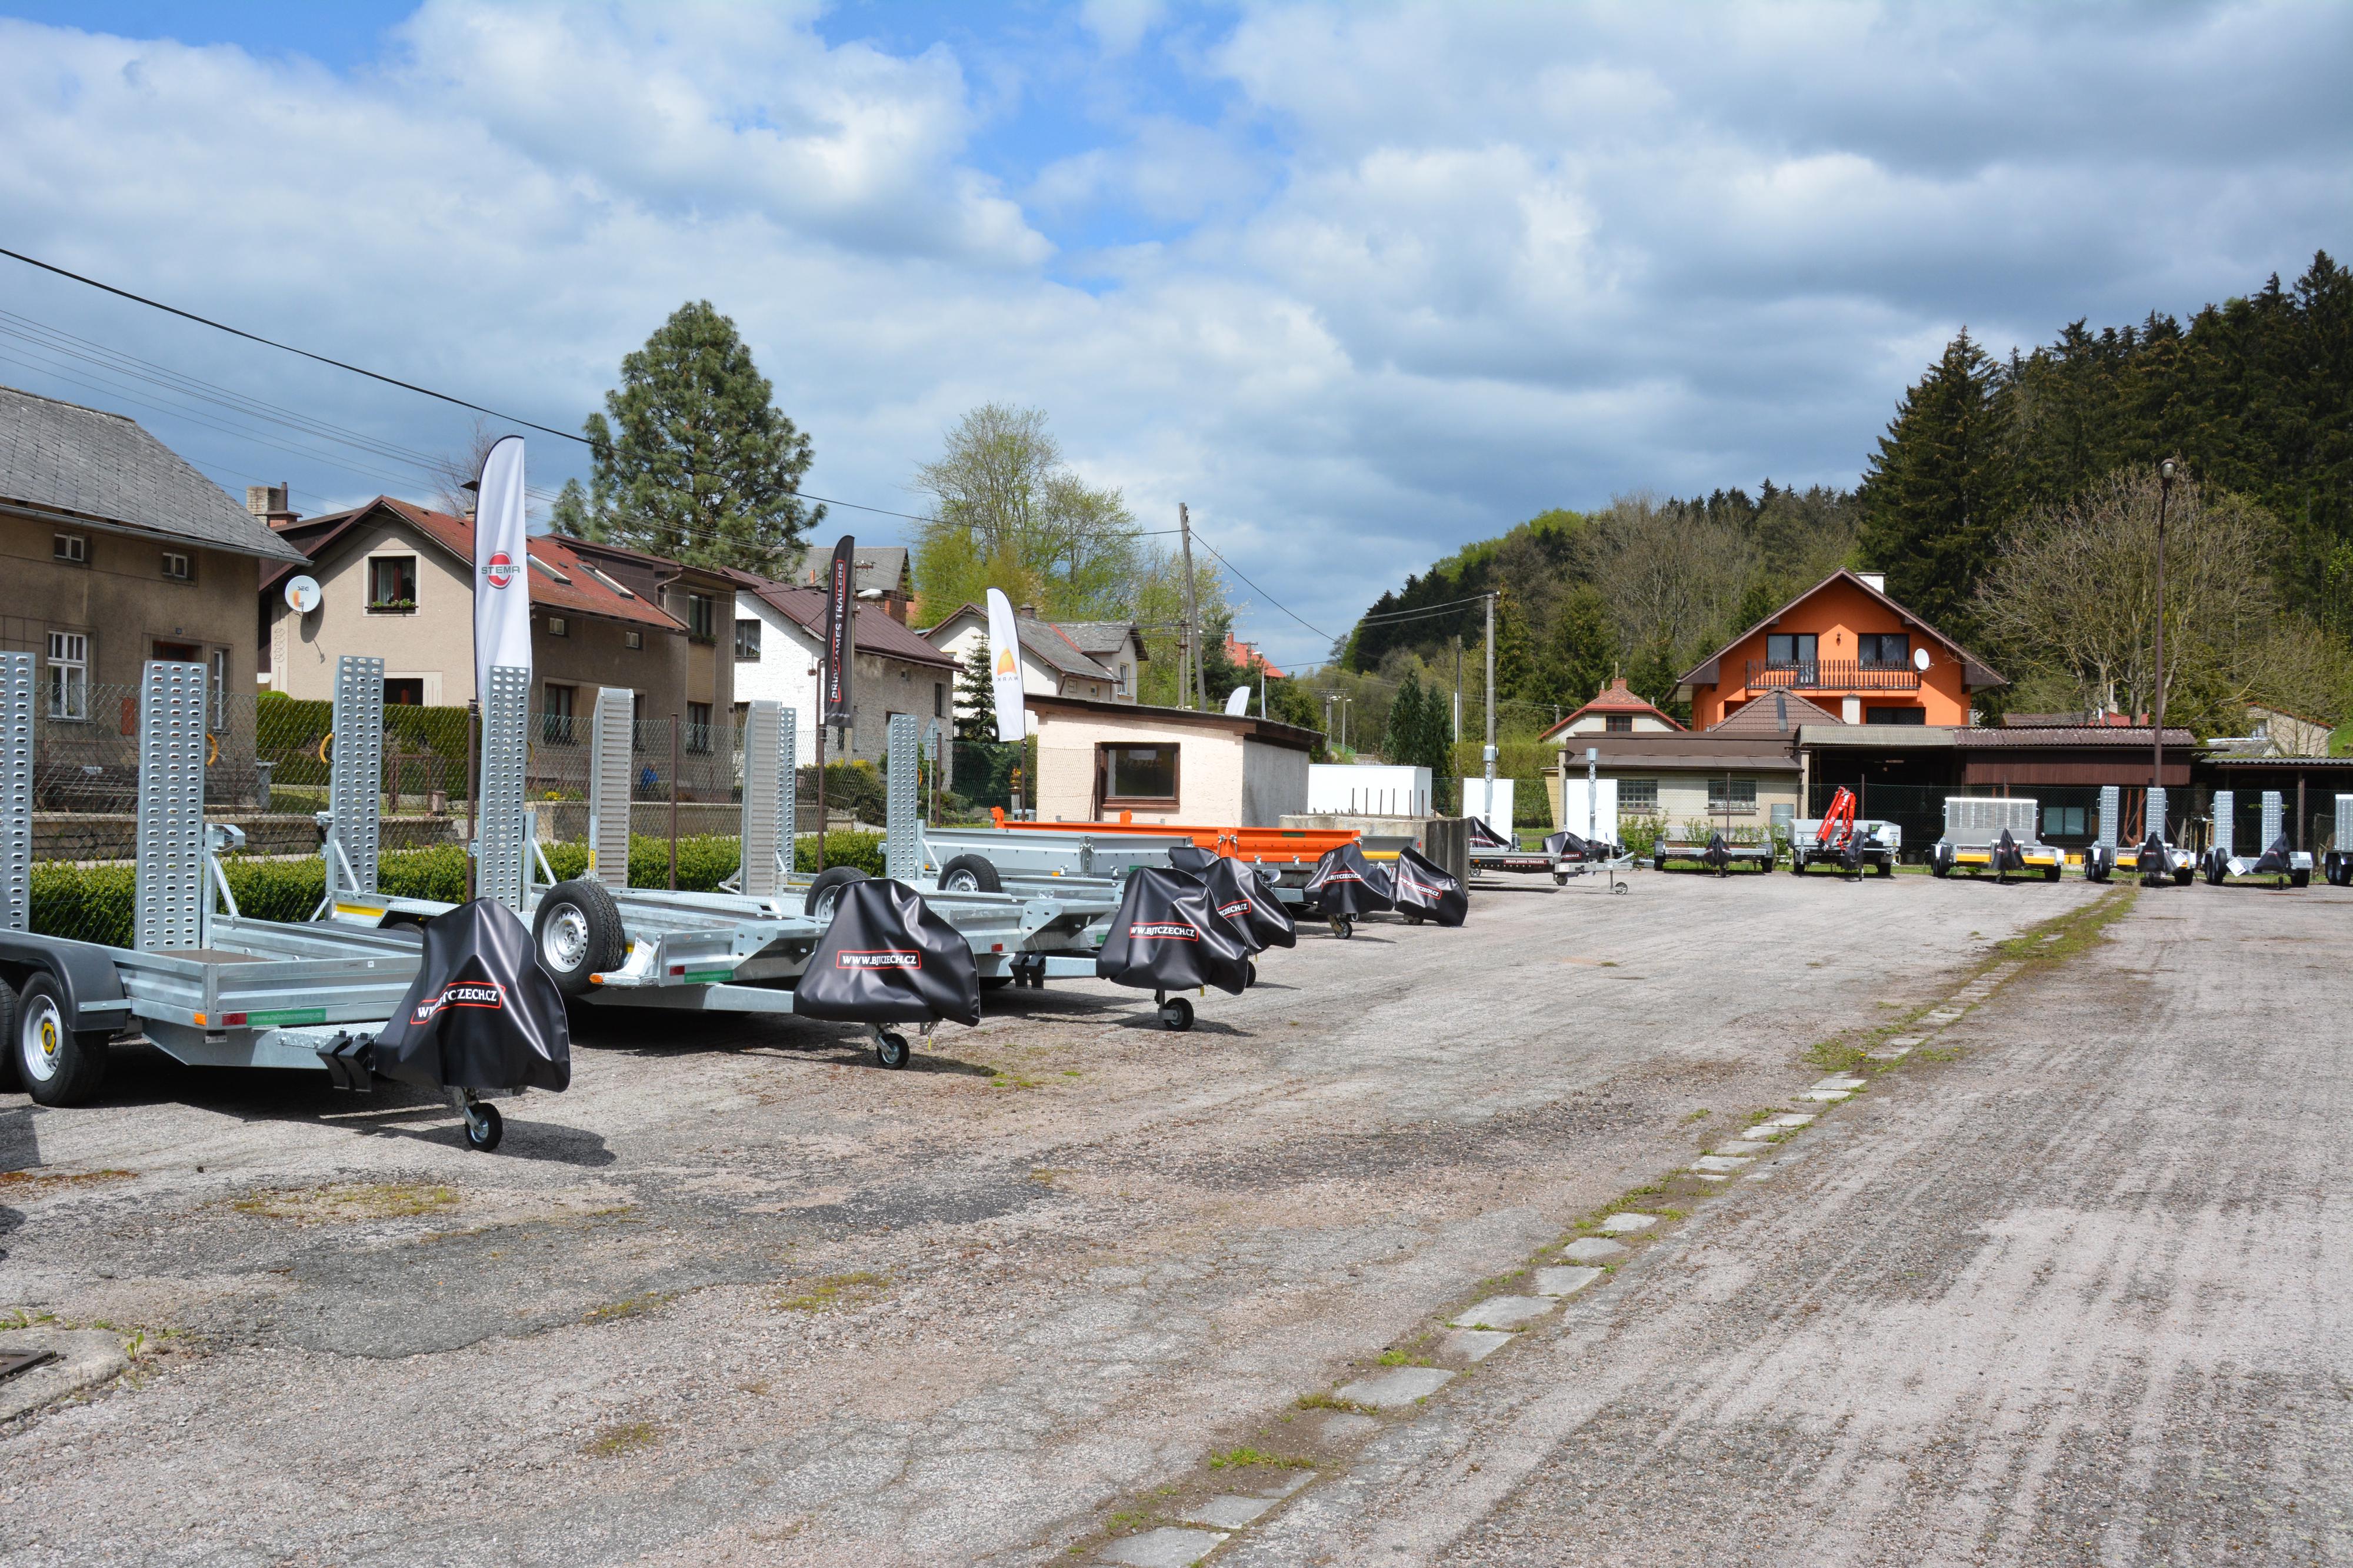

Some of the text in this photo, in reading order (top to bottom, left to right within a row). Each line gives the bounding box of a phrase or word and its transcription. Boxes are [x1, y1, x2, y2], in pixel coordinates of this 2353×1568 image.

[481, 566, 520, 574] STEMA
[835, 563, 844, 620] TRAILERS
[842, 955, 916, 966] WWW.BJTCZECH.CZ
